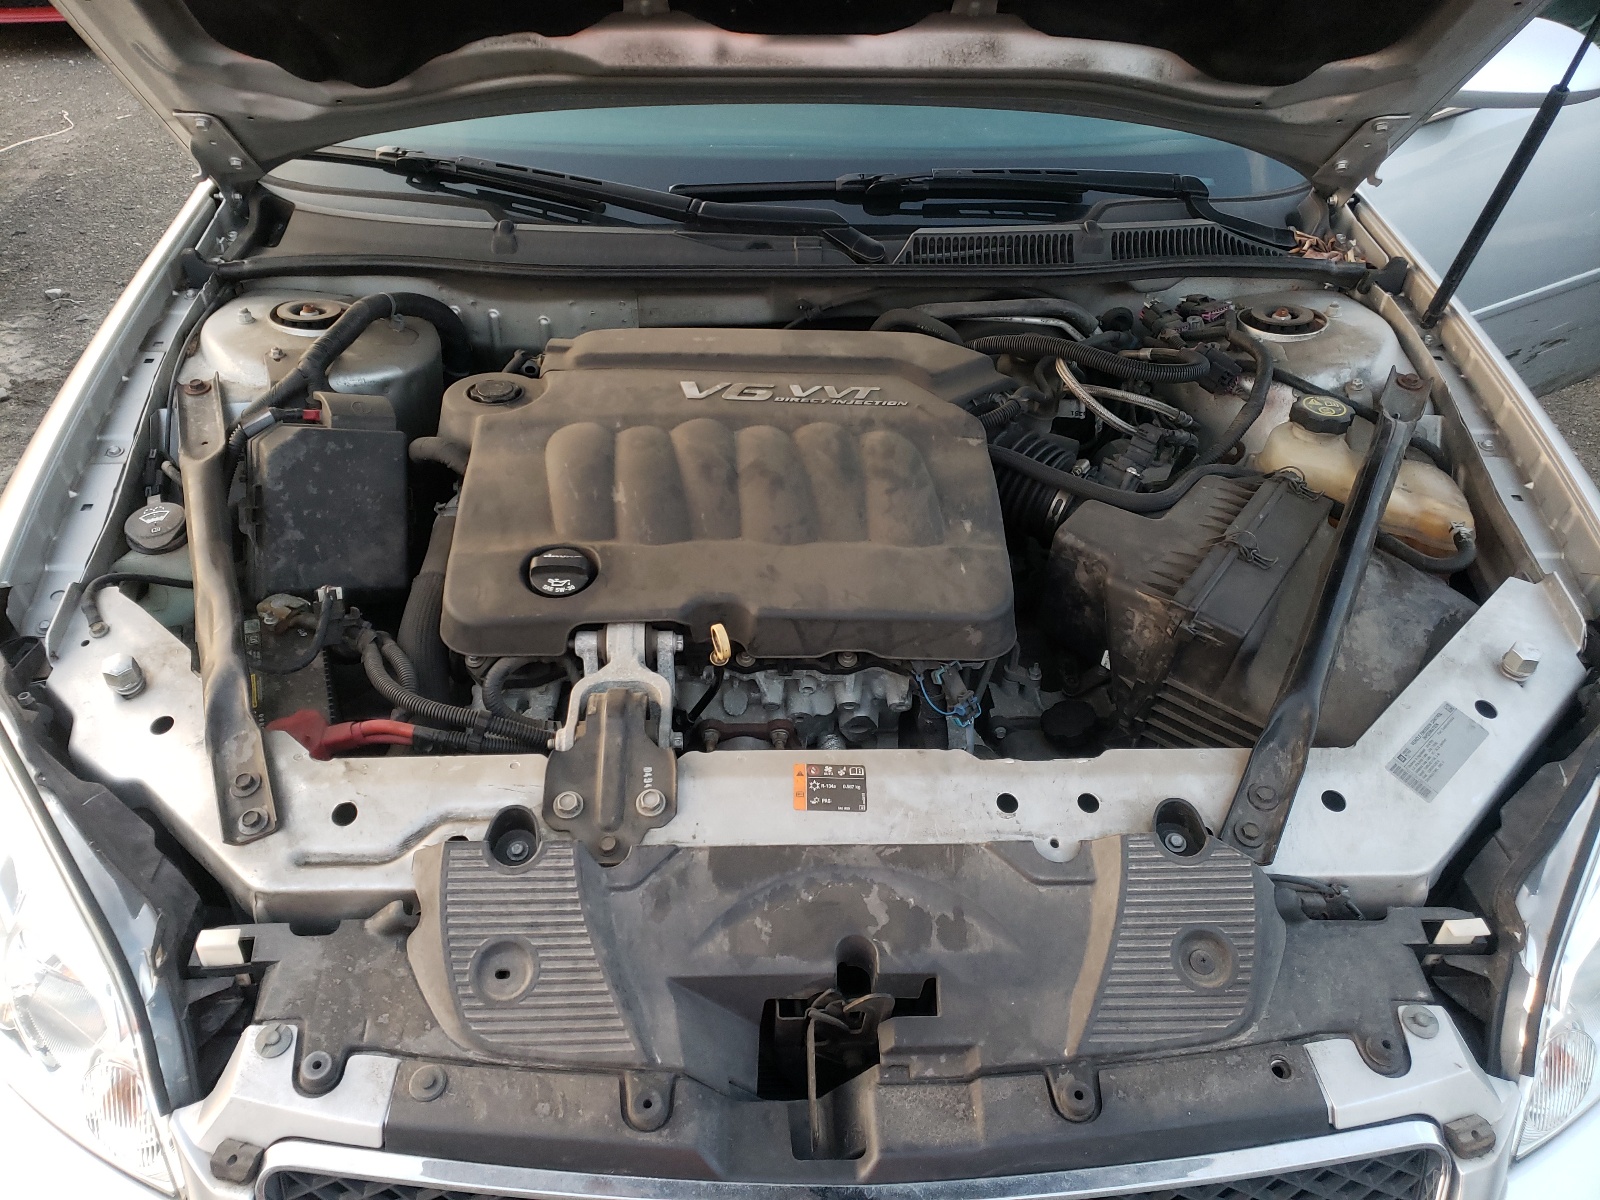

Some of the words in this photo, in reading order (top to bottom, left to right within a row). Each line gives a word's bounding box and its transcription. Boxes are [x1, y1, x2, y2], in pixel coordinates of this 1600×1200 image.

[680, 381, 776, 401] V6
[789, 384, 881, 399] VVT
[773, 396, 828, 404] DIRECT
[542, 584, 554, 592] SAE
[555, 584, 576, 593] 5W-30
